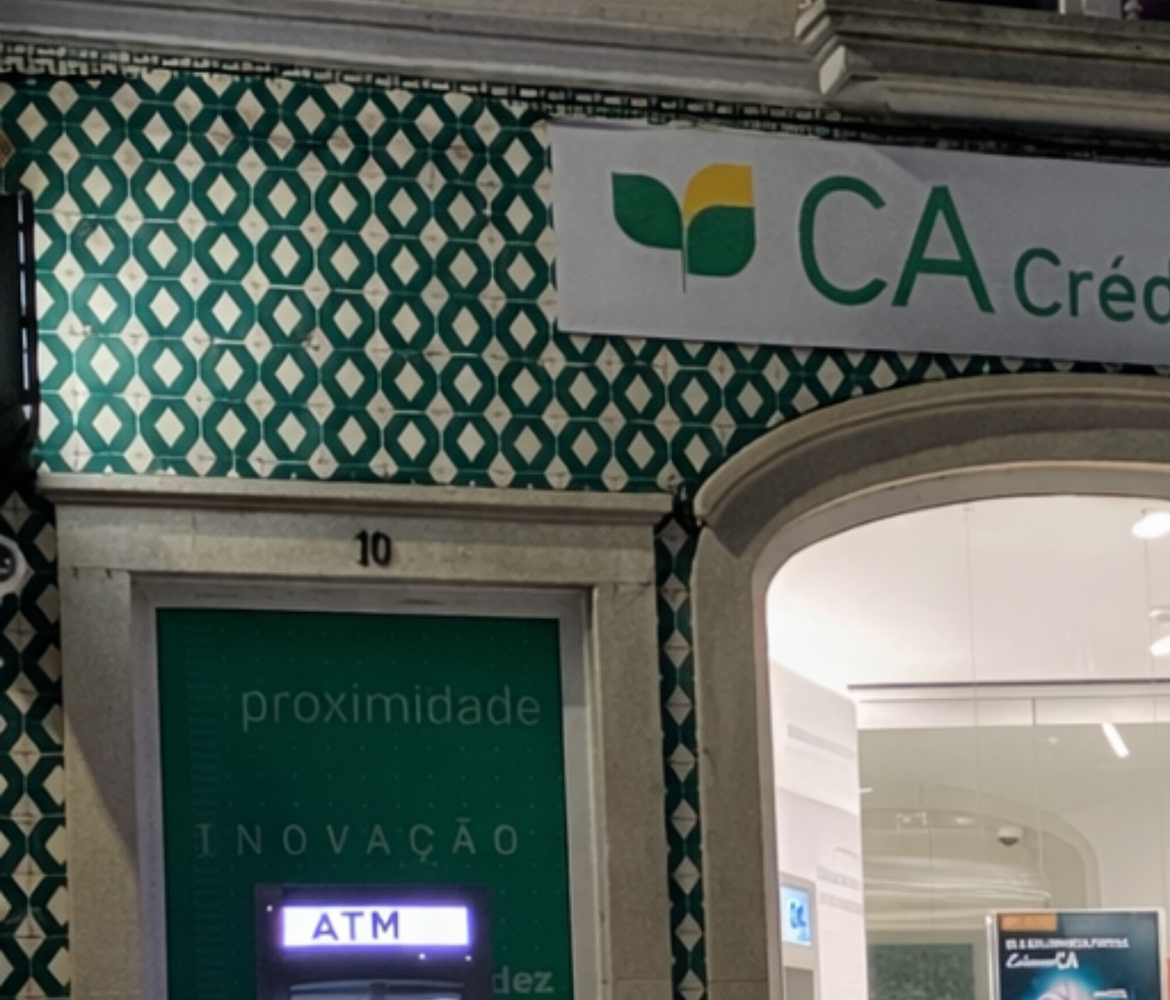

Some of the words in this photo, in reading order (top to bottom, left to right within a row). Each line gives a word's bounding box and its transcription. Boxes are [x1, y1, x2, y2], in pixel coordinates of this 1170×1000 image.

[799, 173, 994, 315] CA
[355, 530, 392, 568] 10
[240, 683, 541, 732] proximidade
[196, 817, 519, 864] INOVAÇÃO
[312, 911, 401, 941] ATM
